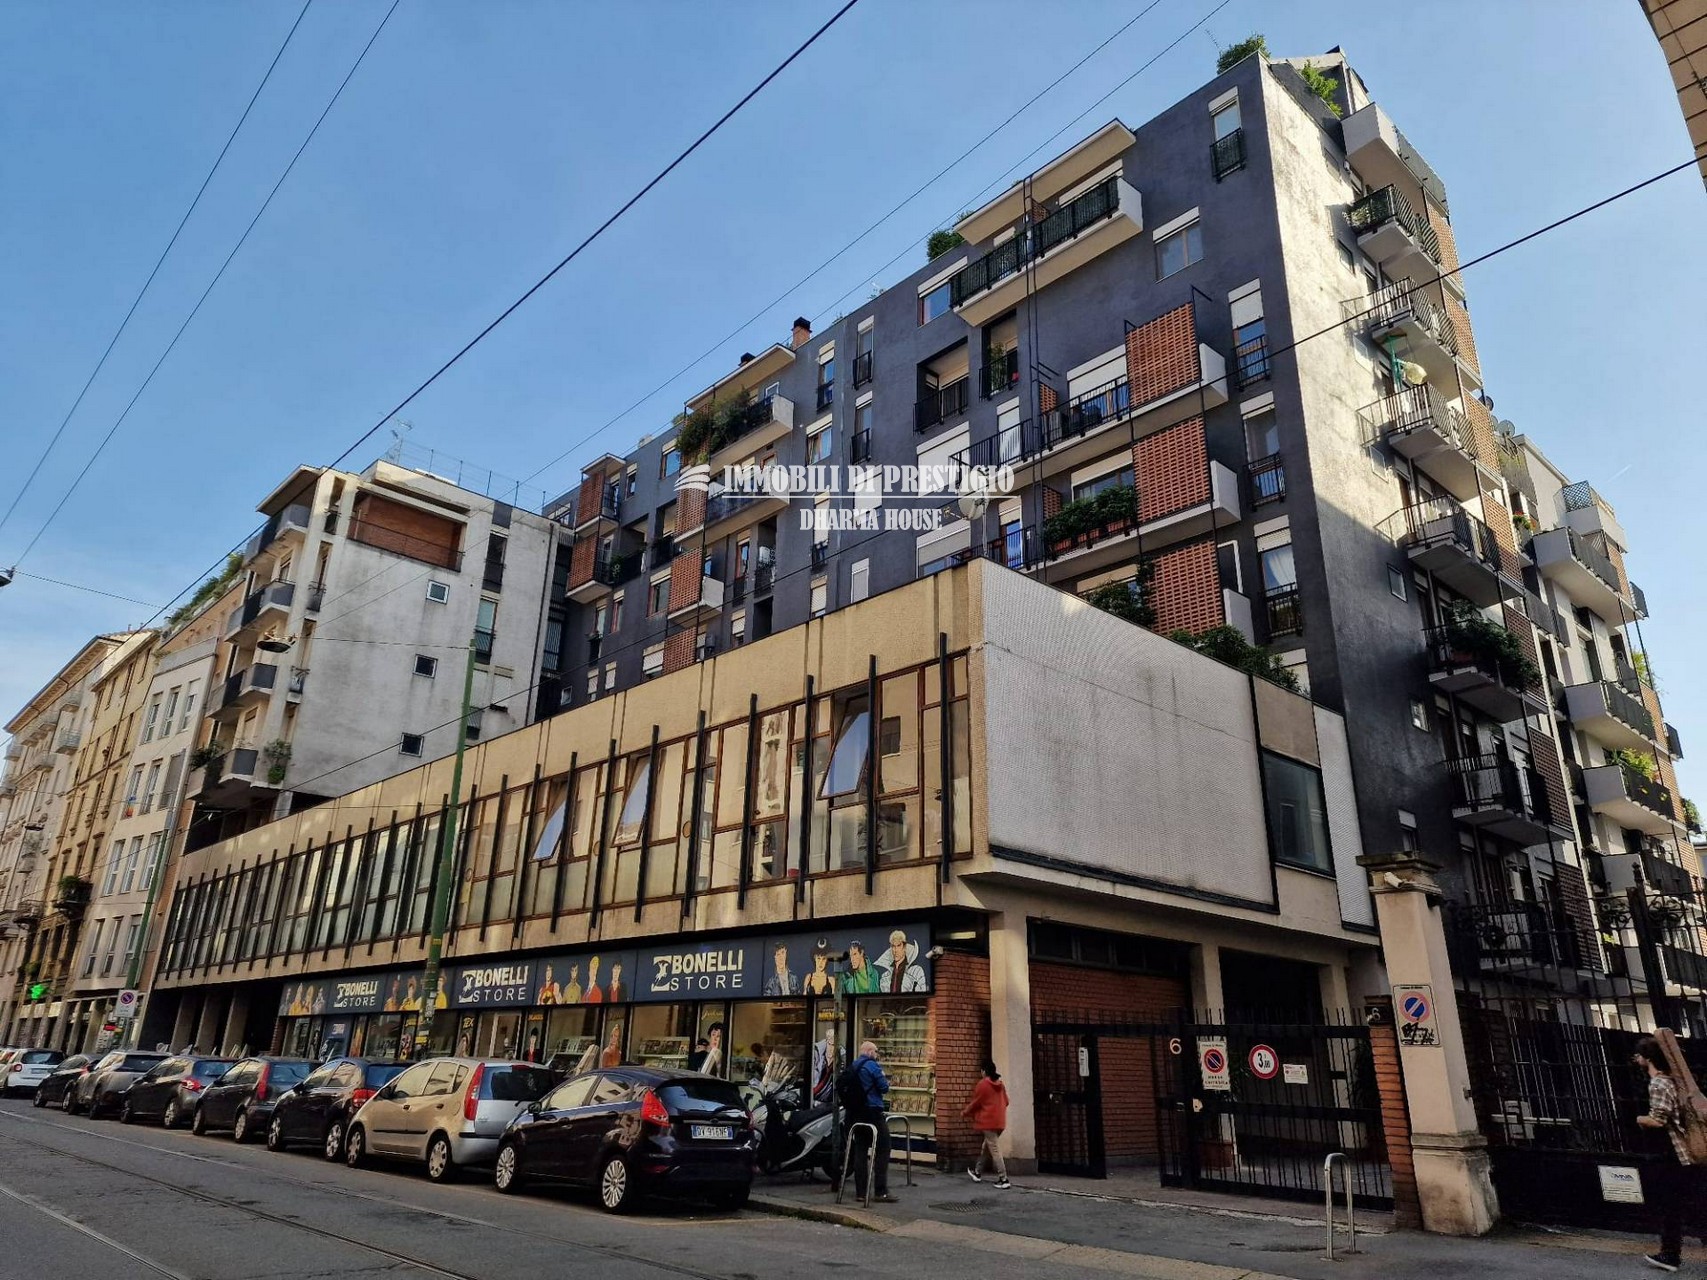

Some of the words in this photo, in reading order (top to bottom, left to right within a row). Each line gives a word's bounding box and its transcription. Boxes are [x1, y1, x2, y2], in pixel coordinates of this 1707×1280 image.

[671, 949, 743, 974] BONELLI
[475, 965, 528, 986] BONELLI
[671, 973, 742, 992] STORE
[344, 981, 379, 996] BONELLI
[473, 986, 526, 1003] STORE
[343, 996, 376, 1008] STORE
[1169, 1038, 1182, 1055] 6
